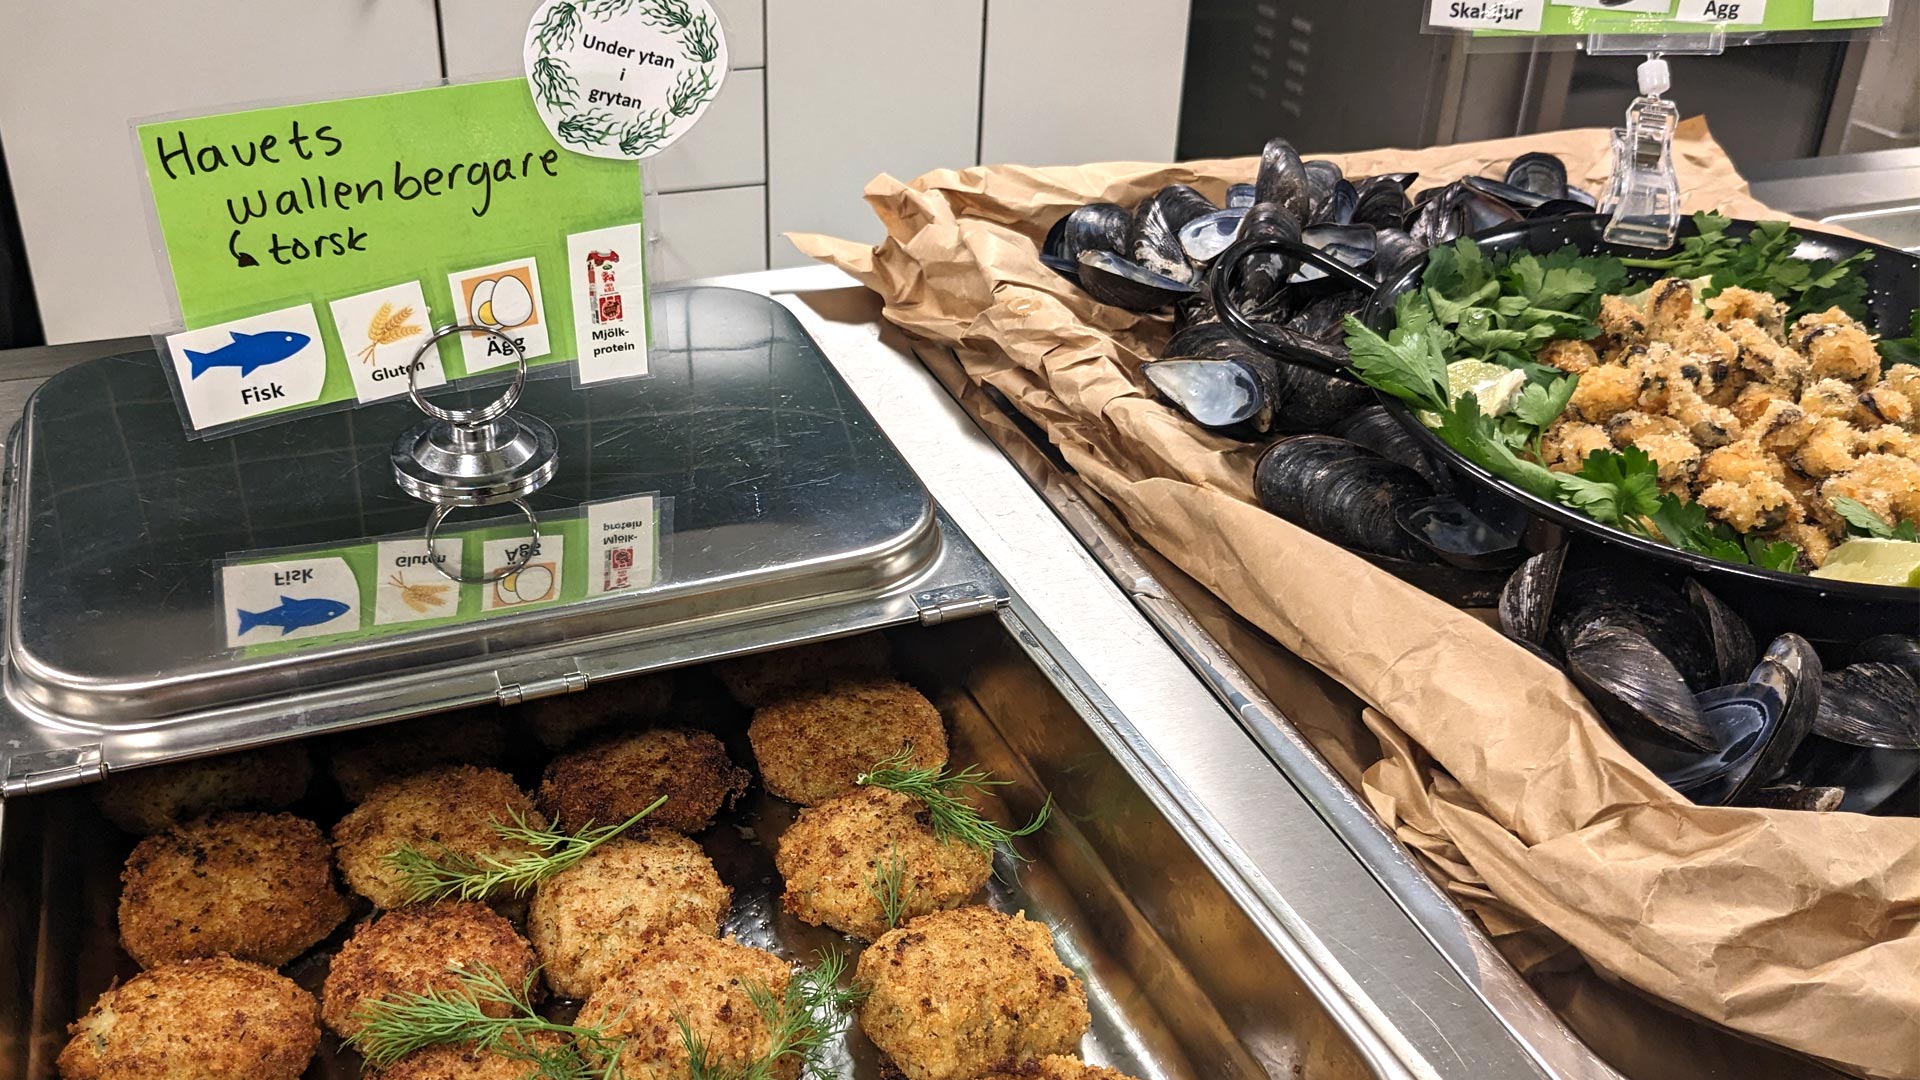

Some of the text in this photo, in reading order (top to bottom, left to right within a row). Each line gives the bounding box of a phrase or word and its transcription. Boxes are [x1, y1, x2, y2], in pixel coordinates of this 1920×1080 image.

[583, 33, 675, 69] Under ytan
[619, 68, 626, 81] i
[588, 89, 642, 109] grytan
[268, 227, 368, 265] torsk
[592, 327, 629, 341] Mjölk-
[593, 342, 635, 357] protein
[241, 382, 285, 405] Fisk
